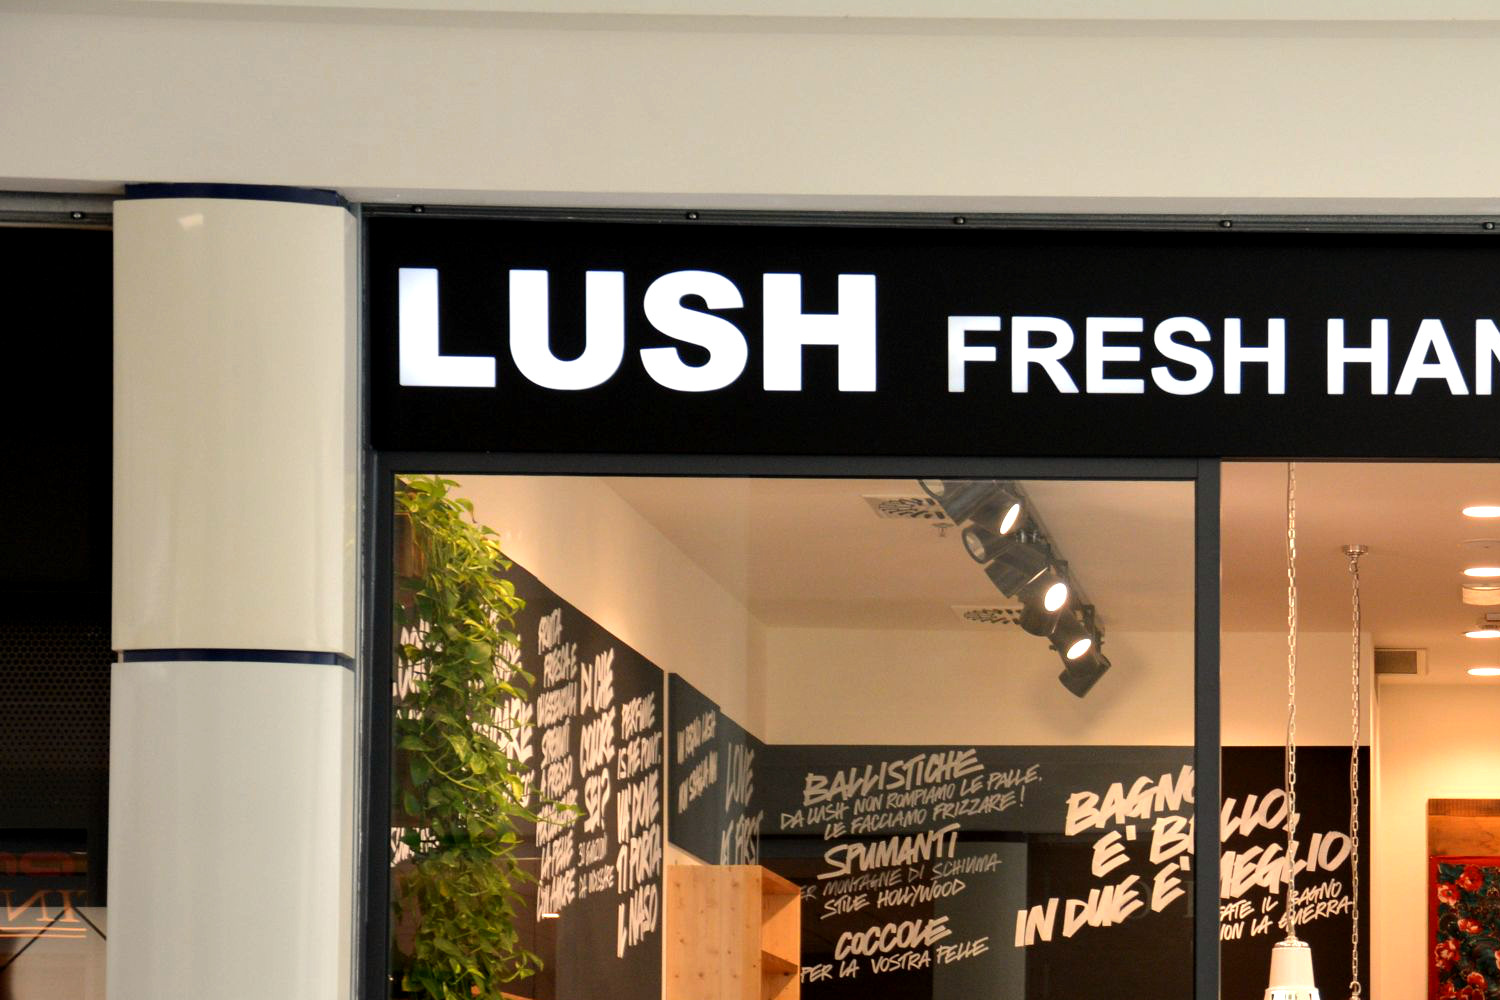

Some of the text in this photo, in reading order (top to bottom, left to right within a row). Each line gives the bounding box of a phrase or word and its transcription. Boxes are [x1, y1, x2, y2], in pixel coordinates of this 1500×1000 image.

[398, 267, 877, 393] LUSH
[947, 315, 1286, 396] FRESH
[803, 749, 985, 806] BALLISTICHE
[781, 810, 805, 830] DA
[854, 794, 884, 815] NON
[886, 783, 956, 809] ROMPIAMO
[960, 776, 983, 794] LE
[824, 822, 847, 841] LE
[851, 808, 927, 834] FACCIAMO
[817, 822, 962, 880] SPUMANTI
[823, 868, 903, 897] MONTAGNE
[908, 865, 924, 884] DI
[931, 853, 1003, 881] SCHIUMA
[1261, 896, 1279, 914] IL
[1290, 878, 1343, 906] BAGNO
[820, 878, 967, 920] STILE HOLLYWOOD
[1014, 897, 1060, 948] IN
[1062, 874, 1144, 938] DUE
[1250, 915, 1274, 937] LA
[1278, 895, 1355, 933] GUERRA
[800, 936, 990, 983] PER LA VOSTRA PELLE
[834, 915, 953, 962] COCCOLE
